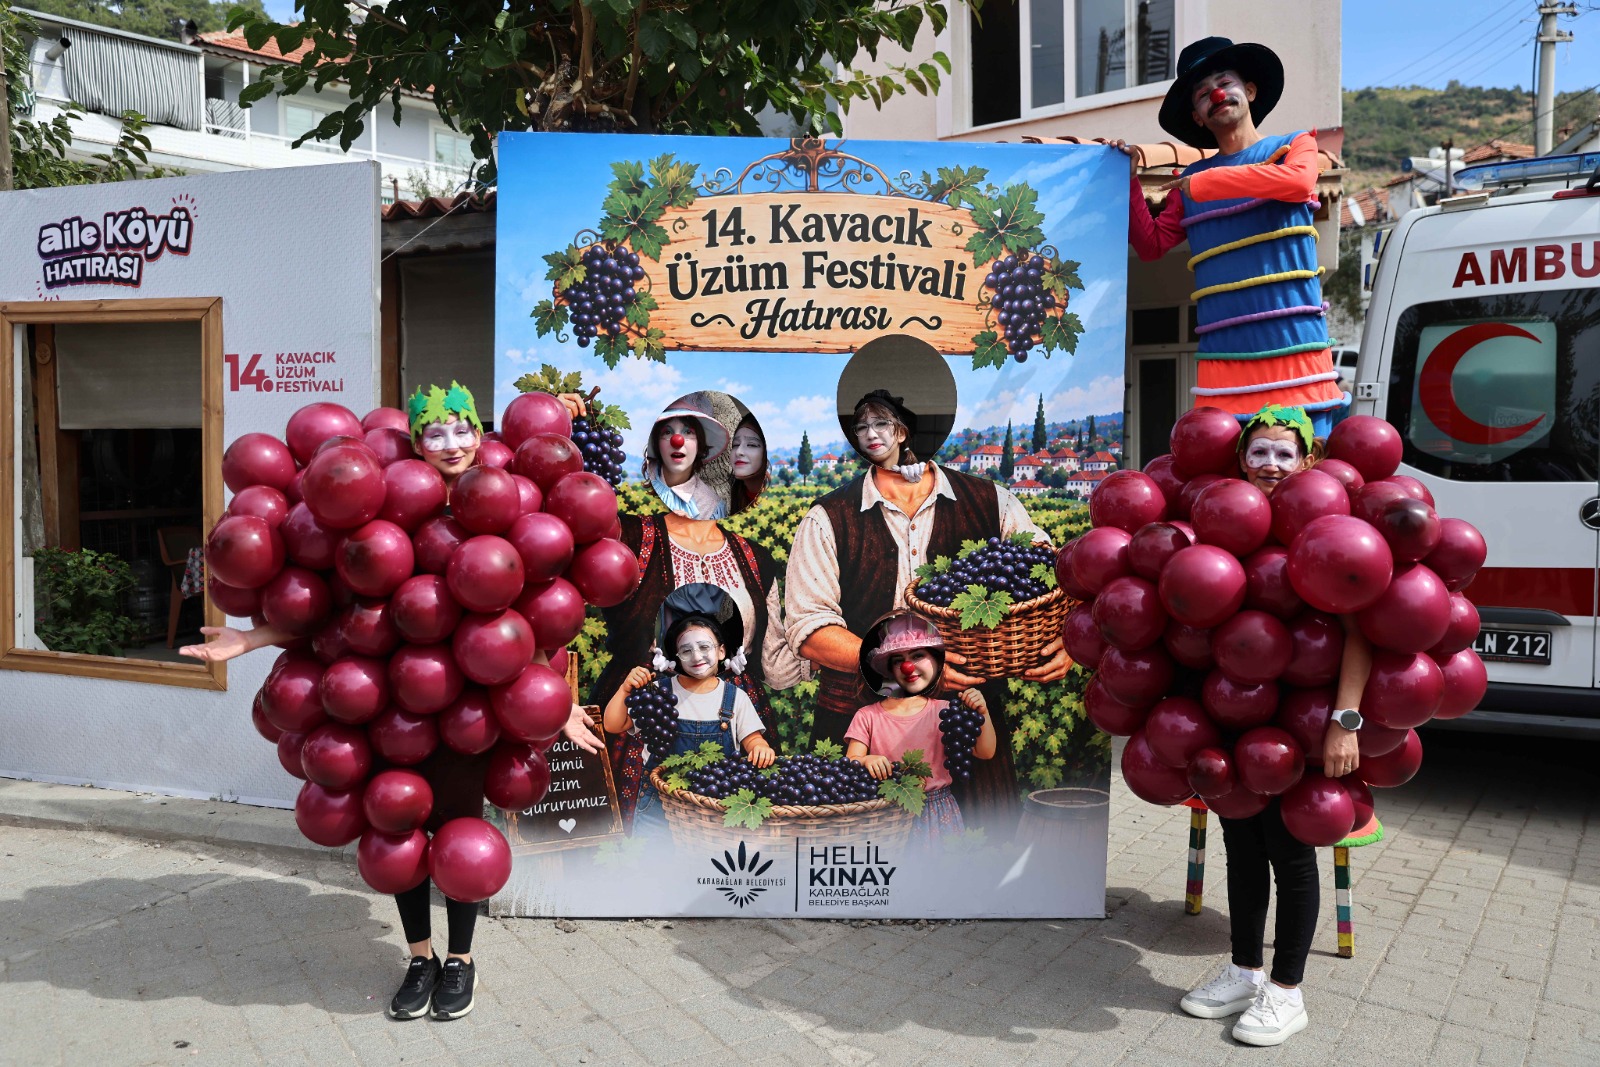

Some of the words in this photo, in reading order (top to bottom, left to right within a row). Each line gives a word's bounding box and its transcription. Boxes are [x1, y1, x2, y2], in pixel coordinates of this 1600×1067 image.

[39, 218, 99, 256] aile
[104, 208, 191, 258] Köyü
[701, 206, 756, 249] 14.
[769, 203, 933, 248] Kavacık
[44, 256, 142, 285] HATIRASI
[666, 251, 789, 301] Üzüm
[802, 251, 967, 301] Festivali
[1452, 241, 1600, 288] AMBU
[740, 297, 892, 340] Hatırası
[275, 351, 336, 365] KAVACIK
[224, 353, 274, 392] 14.
[275, 365, 316, 379] ÜZÜM
[275, 378, 344, 393] FESTİVALİ
[1506, 634, 1546, 657] 212
[810, 840, 889, 866] HELİL
[697, 877, 743, 886] KARABAĞLAR
[746, 877, 786, 886] BELEDİYESİ
[809, 867, 897, 887] KINAY
[809, 887, 890, 898] KARABAĞLAR
[809, 898, 850, 907] BELEDİYE
[852, 898, 889, 908] BAŞKANI
